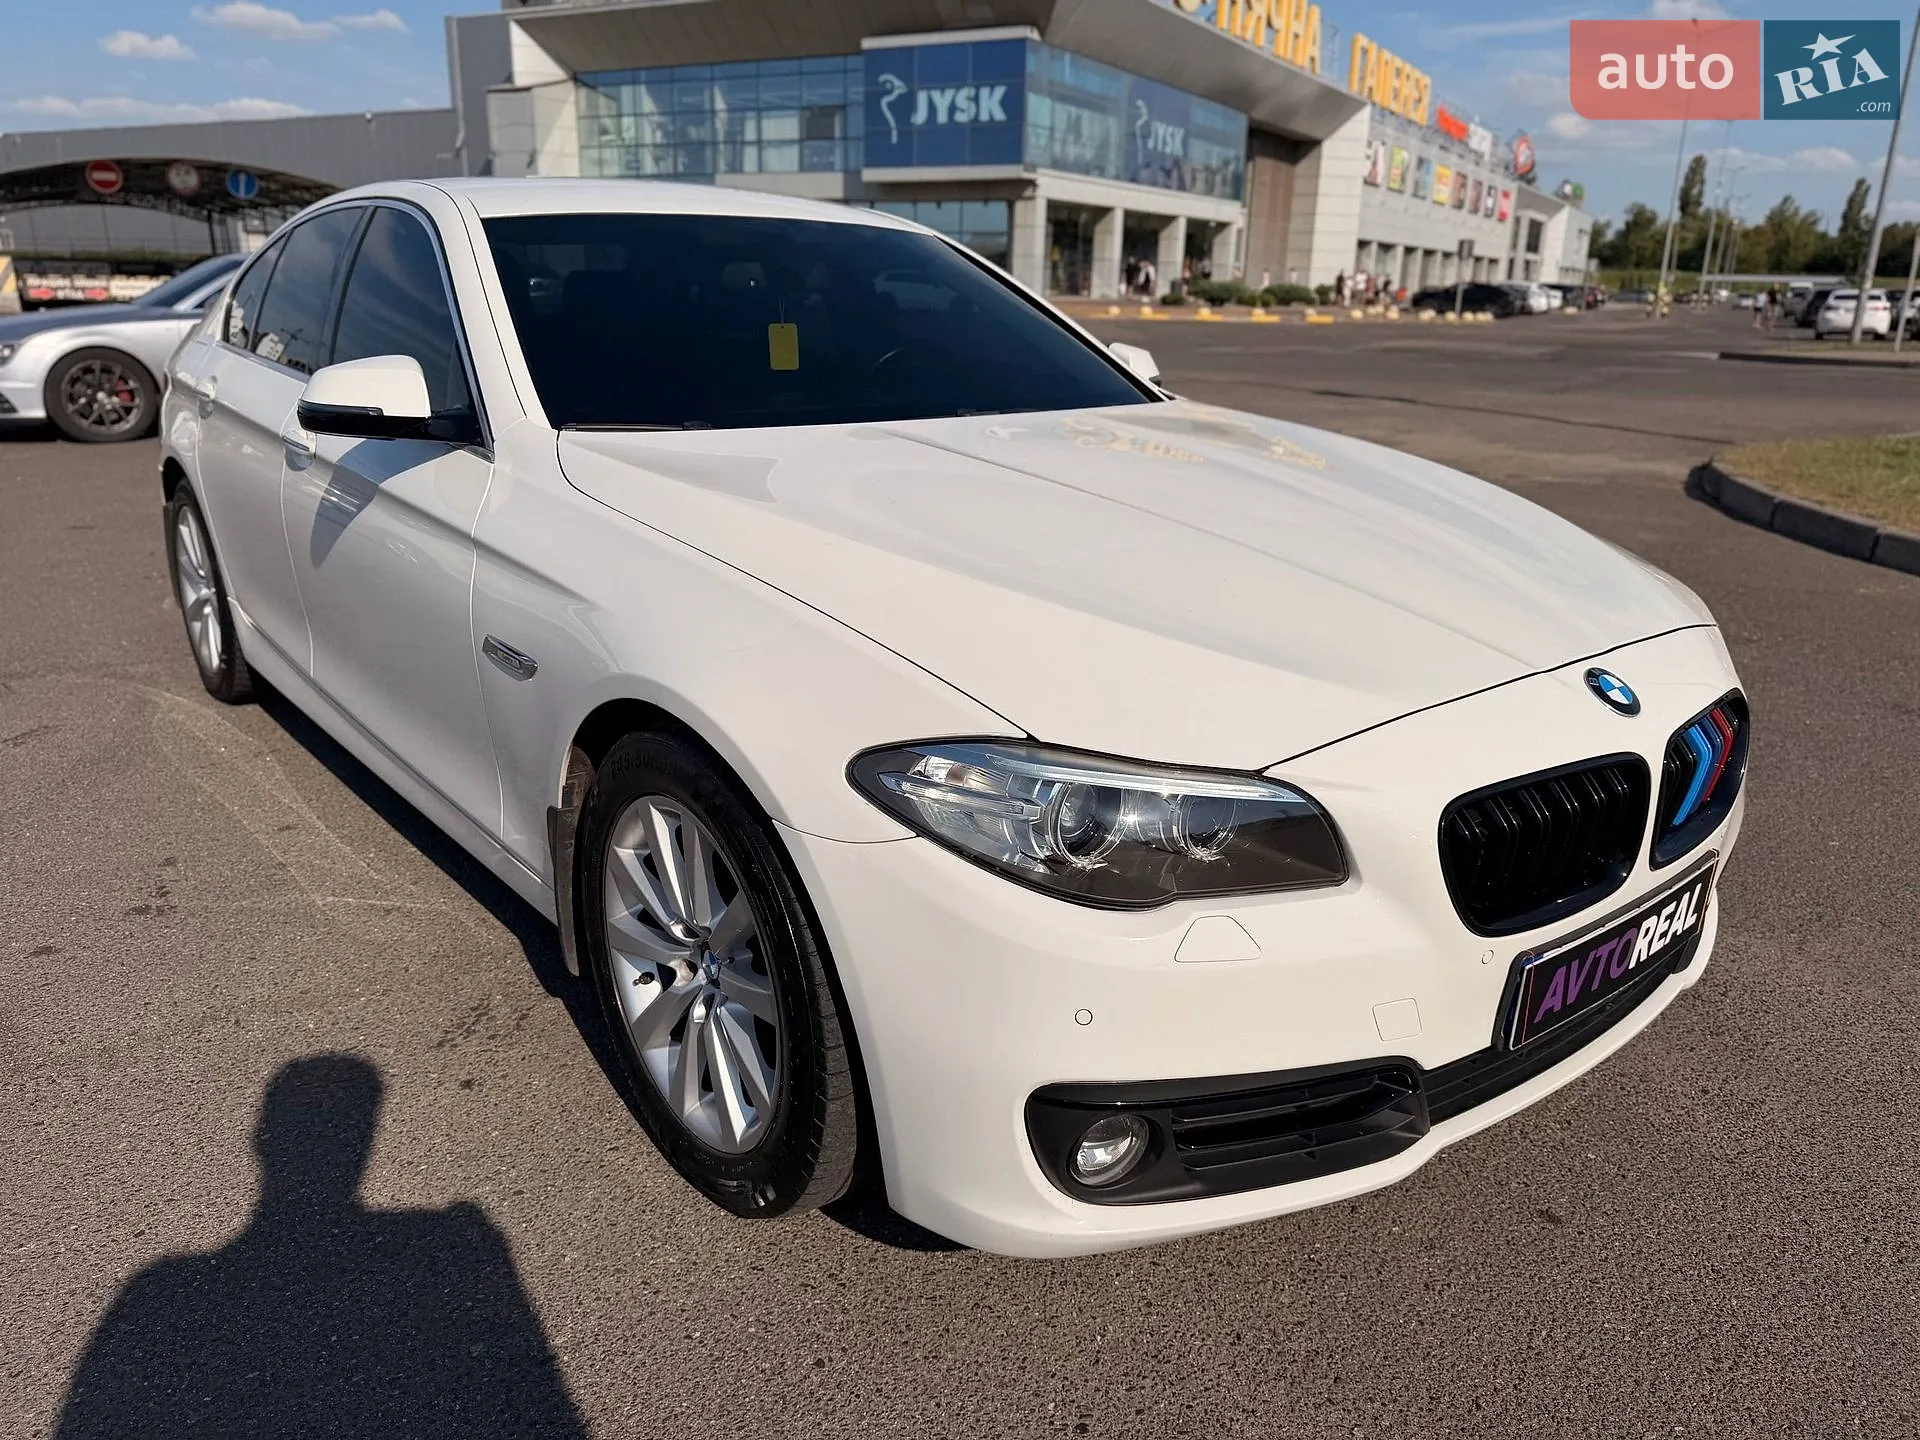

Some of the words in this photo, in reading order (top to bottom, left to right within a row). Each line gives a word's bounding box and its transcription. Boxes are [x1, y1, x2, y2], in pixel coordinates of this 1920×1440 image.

[910, 85, 1009, 126] JYSK
[1147, 120, 1186, 157] JYSK
[1533, 882, 1703, 1024] AVTOREAL
